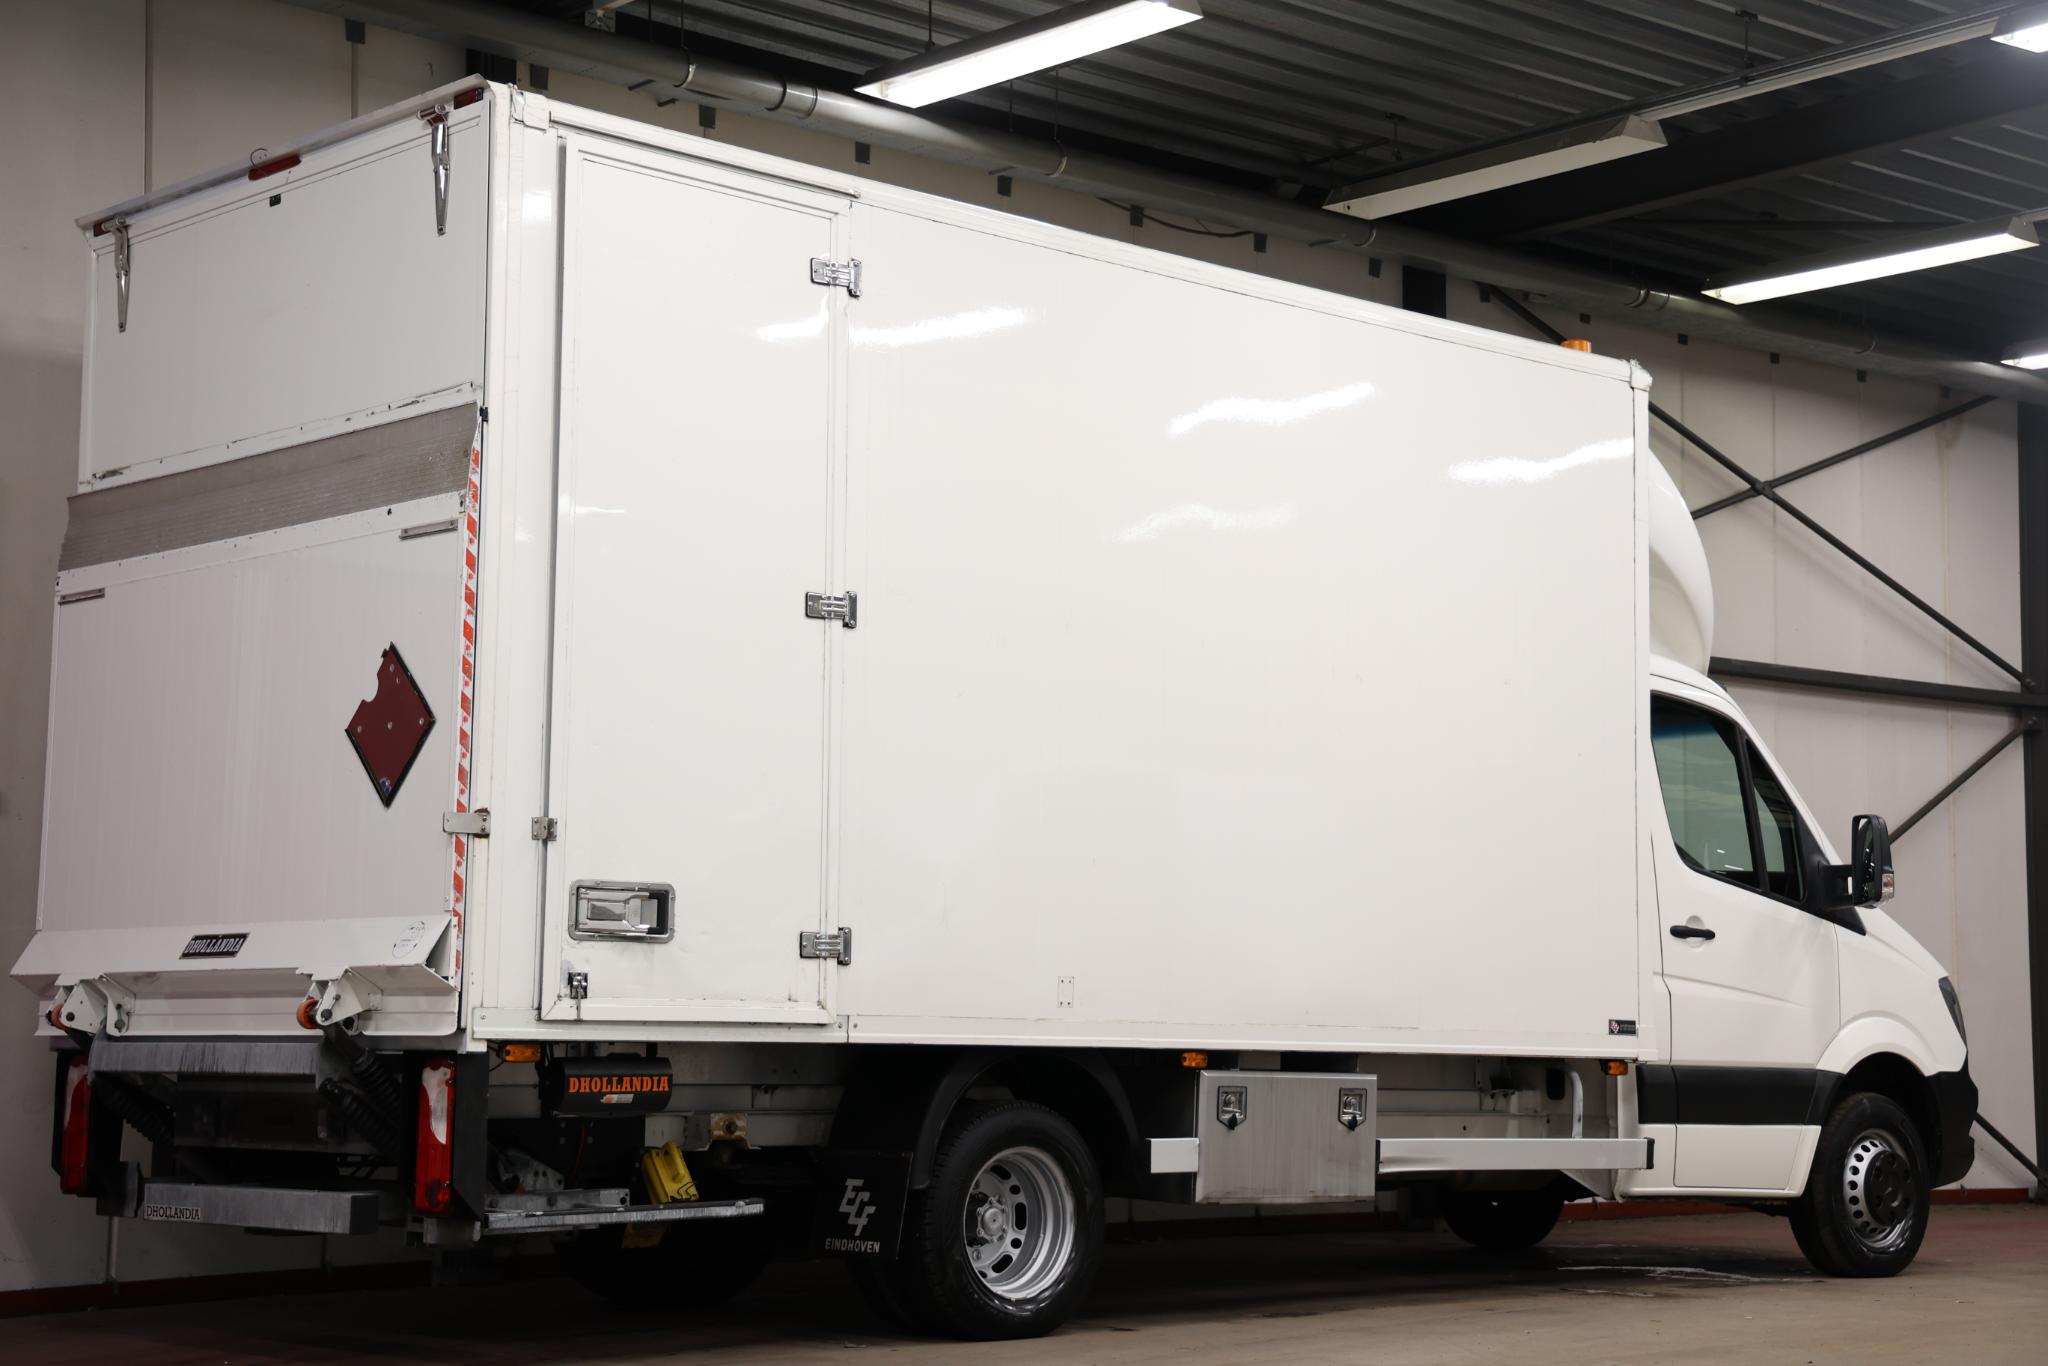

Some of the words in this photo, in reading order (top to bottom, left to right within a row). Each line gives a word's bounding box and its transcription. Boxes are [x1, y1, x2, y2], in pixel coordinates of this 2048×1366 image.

[183, 938, 244, 954] DHOLLANDIA
[569, 1076, 669, 1093] DHOLLANDIA
[146, 1205, 200, 1220] DHOLLANDIA
[825, 1238, 880, 1253] EINDHOVEN
